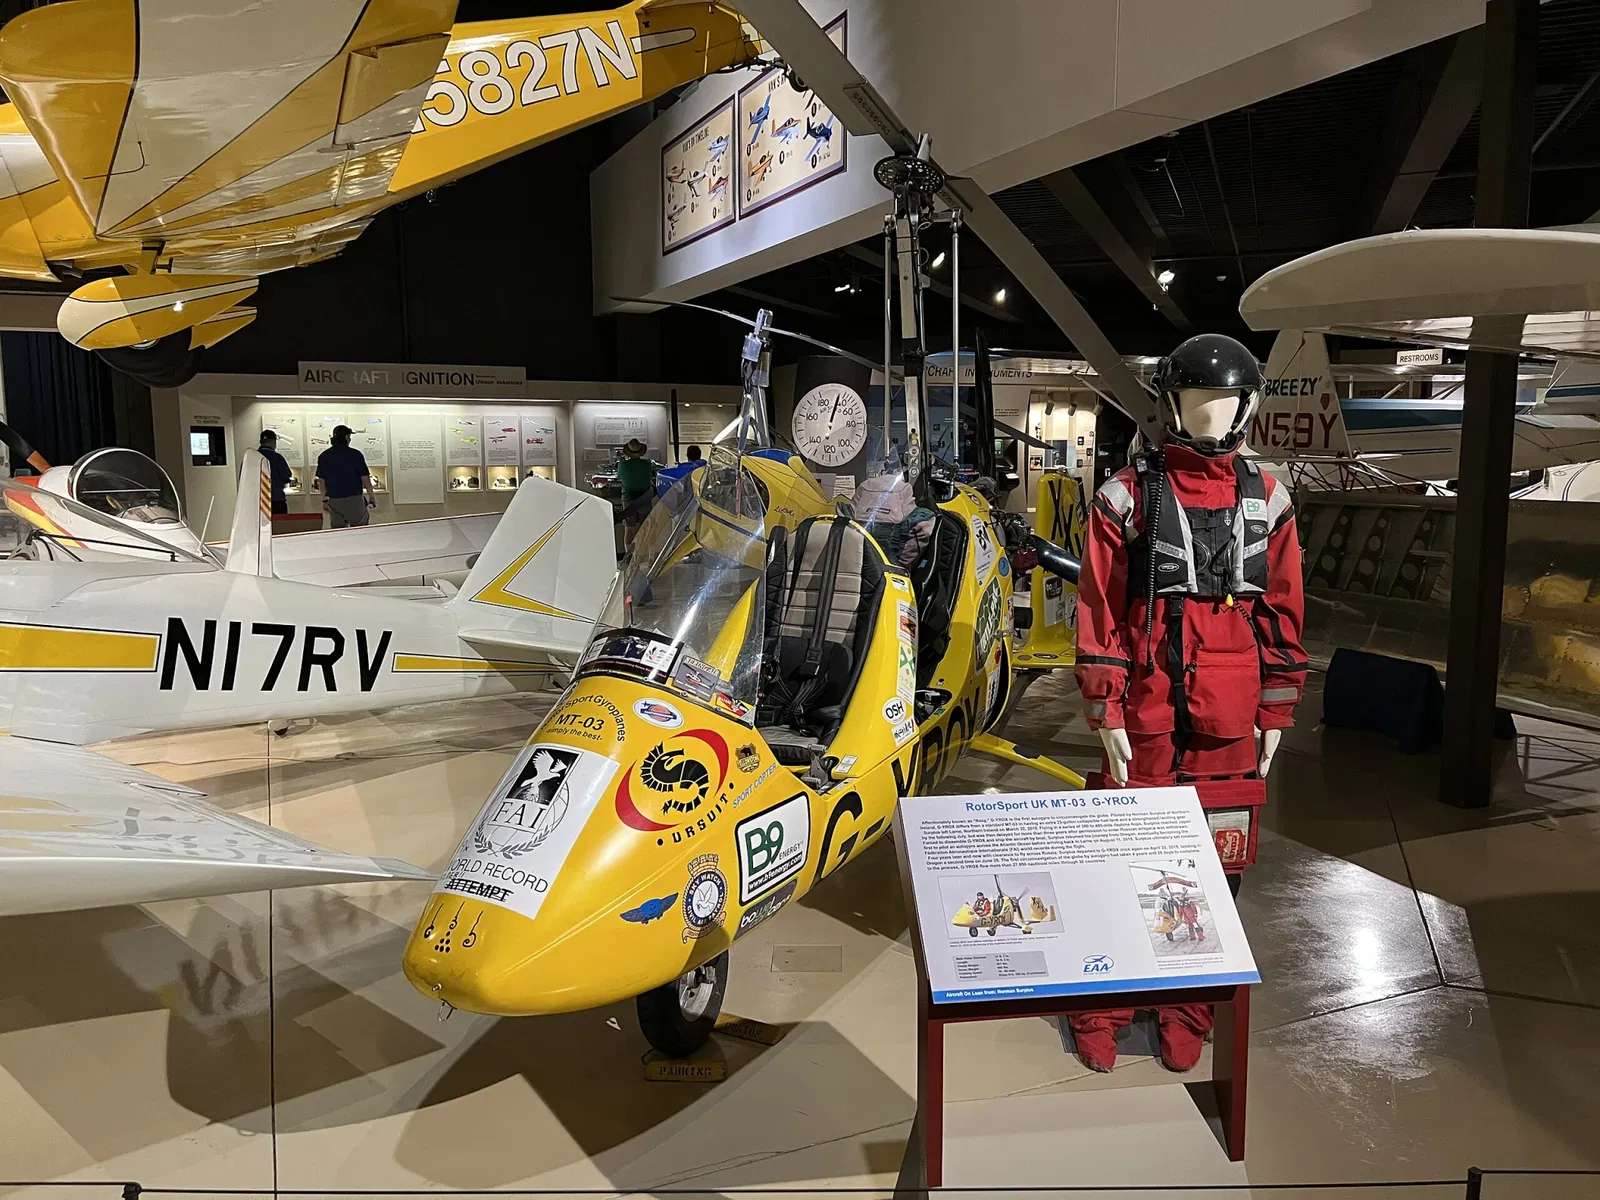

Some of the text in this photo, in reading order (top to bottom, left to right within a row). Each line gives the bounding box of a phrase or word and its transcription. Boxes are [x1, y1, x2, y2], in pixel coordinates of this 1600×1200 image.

[411, 20, 638, 134] 5827N
[1400, 353, 1439, 363] RESTROOMS
[304, 369, 475, 386] AIRCRAFT IGNITION
[817, 398, 829, 407] 180
[806, 412, 818, 421] 160
[842, 407, 853, 416] 60
[845, 420, 857, 428] 80
[1250, 412, 1339, 449] N59Y
[809, 435, 822, 444] 140
[838, 438, 851, 447] 100
[823, 444, 836, 453] 120
[1246, 500, 1260, 512] B9
[159, 617, 393, 693] N17RV
[593, 694, 626, 742] Gyroplanes
[885, 701, 905, 719] OSH
[555, 714, 605, 731] MT-03
[570, 728, 582, 736] the
[733, 762, 777, 808] SPORT COPTER
[965, 796, 1138, 812] RotorSport UK MT-03 G-YROX
[492, 801, 547, 829] FAI
[672, 792, 729, 844] URSUIT
[745, 820, 801, 878] B9 ENERGY
[482, 862, 549, 894] RECORD
[689, 873, 721, 895] SKY WATCH
[687, 905, 697, 924] CIVIL
[1084, 963, 1109, 973] EAA
[660, 1066, 712, 1076] PARKING
